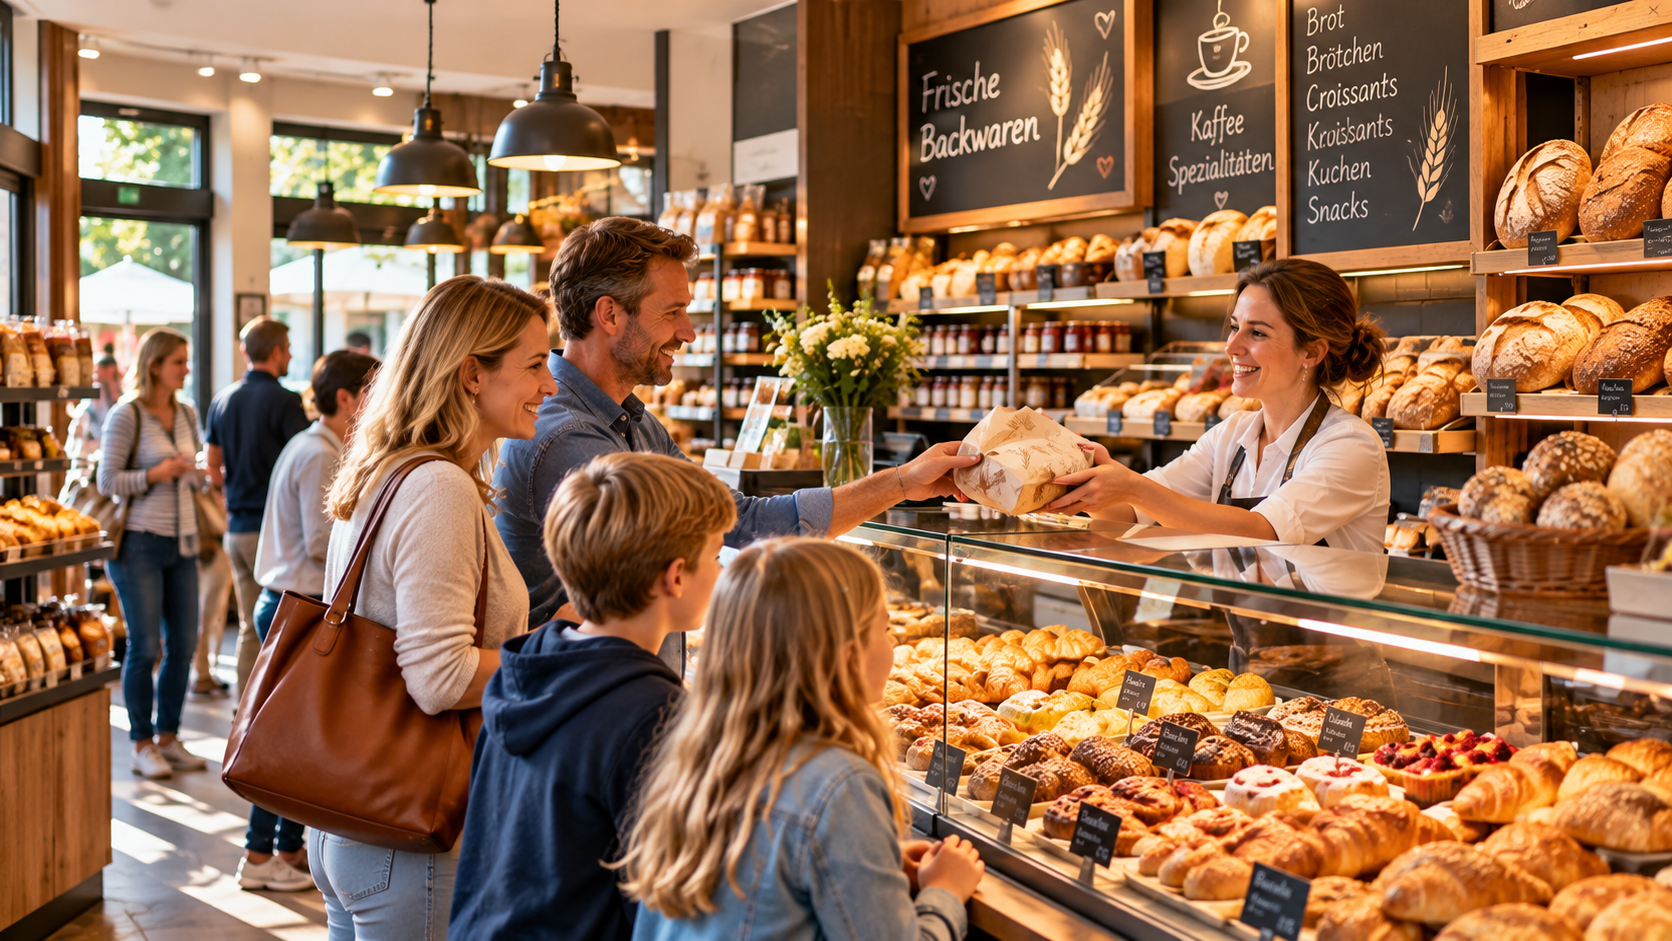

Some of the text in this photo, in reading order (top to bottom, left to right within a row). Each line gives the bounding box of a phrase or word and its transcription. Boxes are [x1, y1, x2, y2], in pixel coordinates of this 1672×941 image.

[1306, 4, 1345, 37] Brot
[1306, 35, 1384, 75] Brötchen
[921, 60, 1001, 114] Frische
[1306, 72, 1398, 112] Croissants
[920, 115, 1041, 163] Backwaren
[1190, 104, 1245, 147] Kaffee
[1307, 154, 1372, 188] Kuchen
[1307, 190, 1369, 225] Snacks
